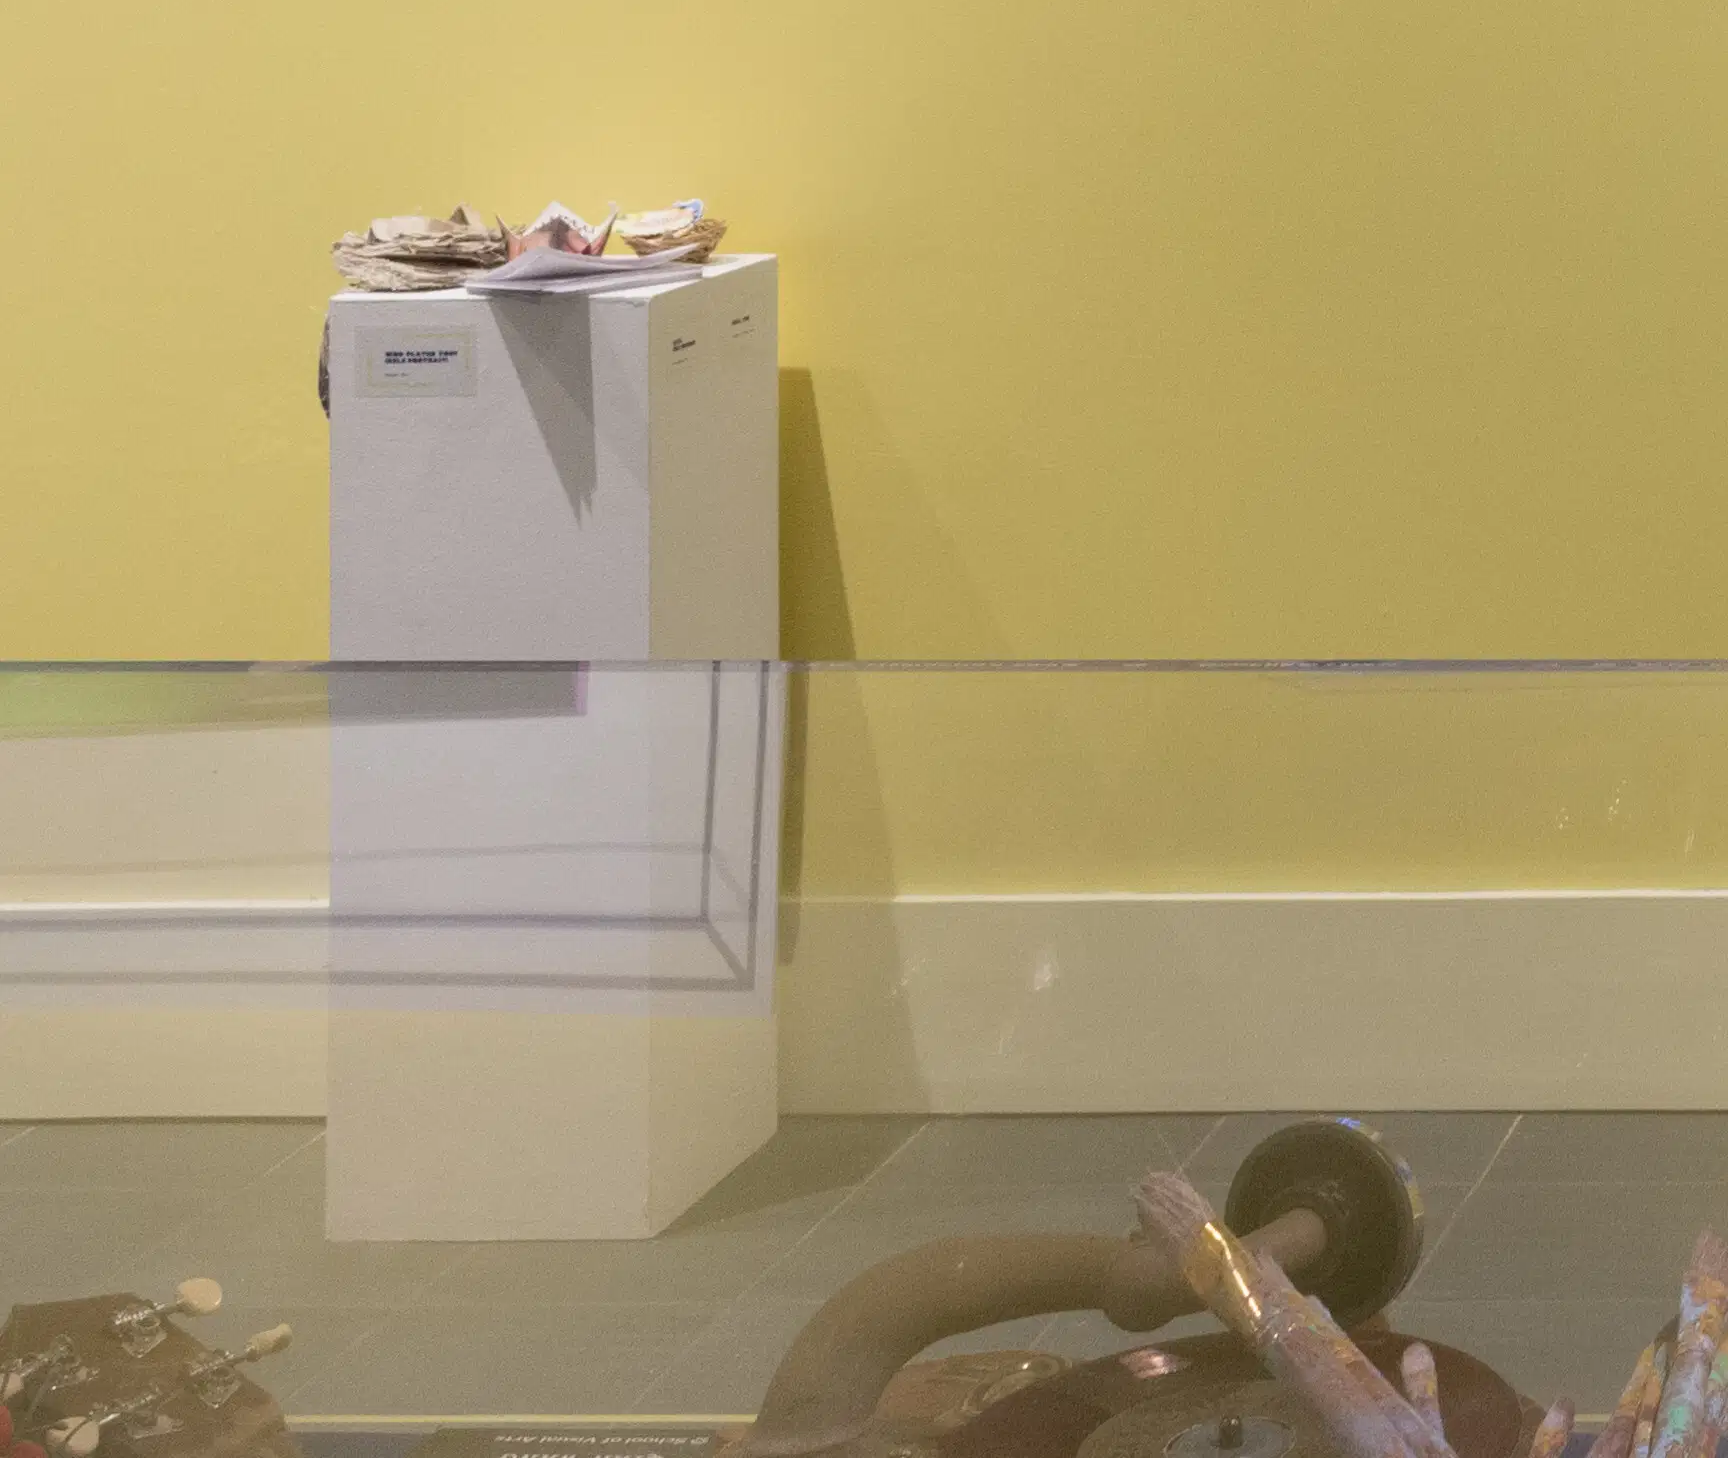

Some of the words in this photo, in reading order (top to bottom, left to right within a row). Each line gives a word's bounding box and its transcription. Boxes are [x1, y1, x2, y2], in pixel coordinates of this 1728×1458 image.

[495, 1435, 538, 1445] Arts
[540, 1436, 597, 1445] Visual
[600, 1437, 621, 1445] of
[622, 1437, 689, 1445] School
